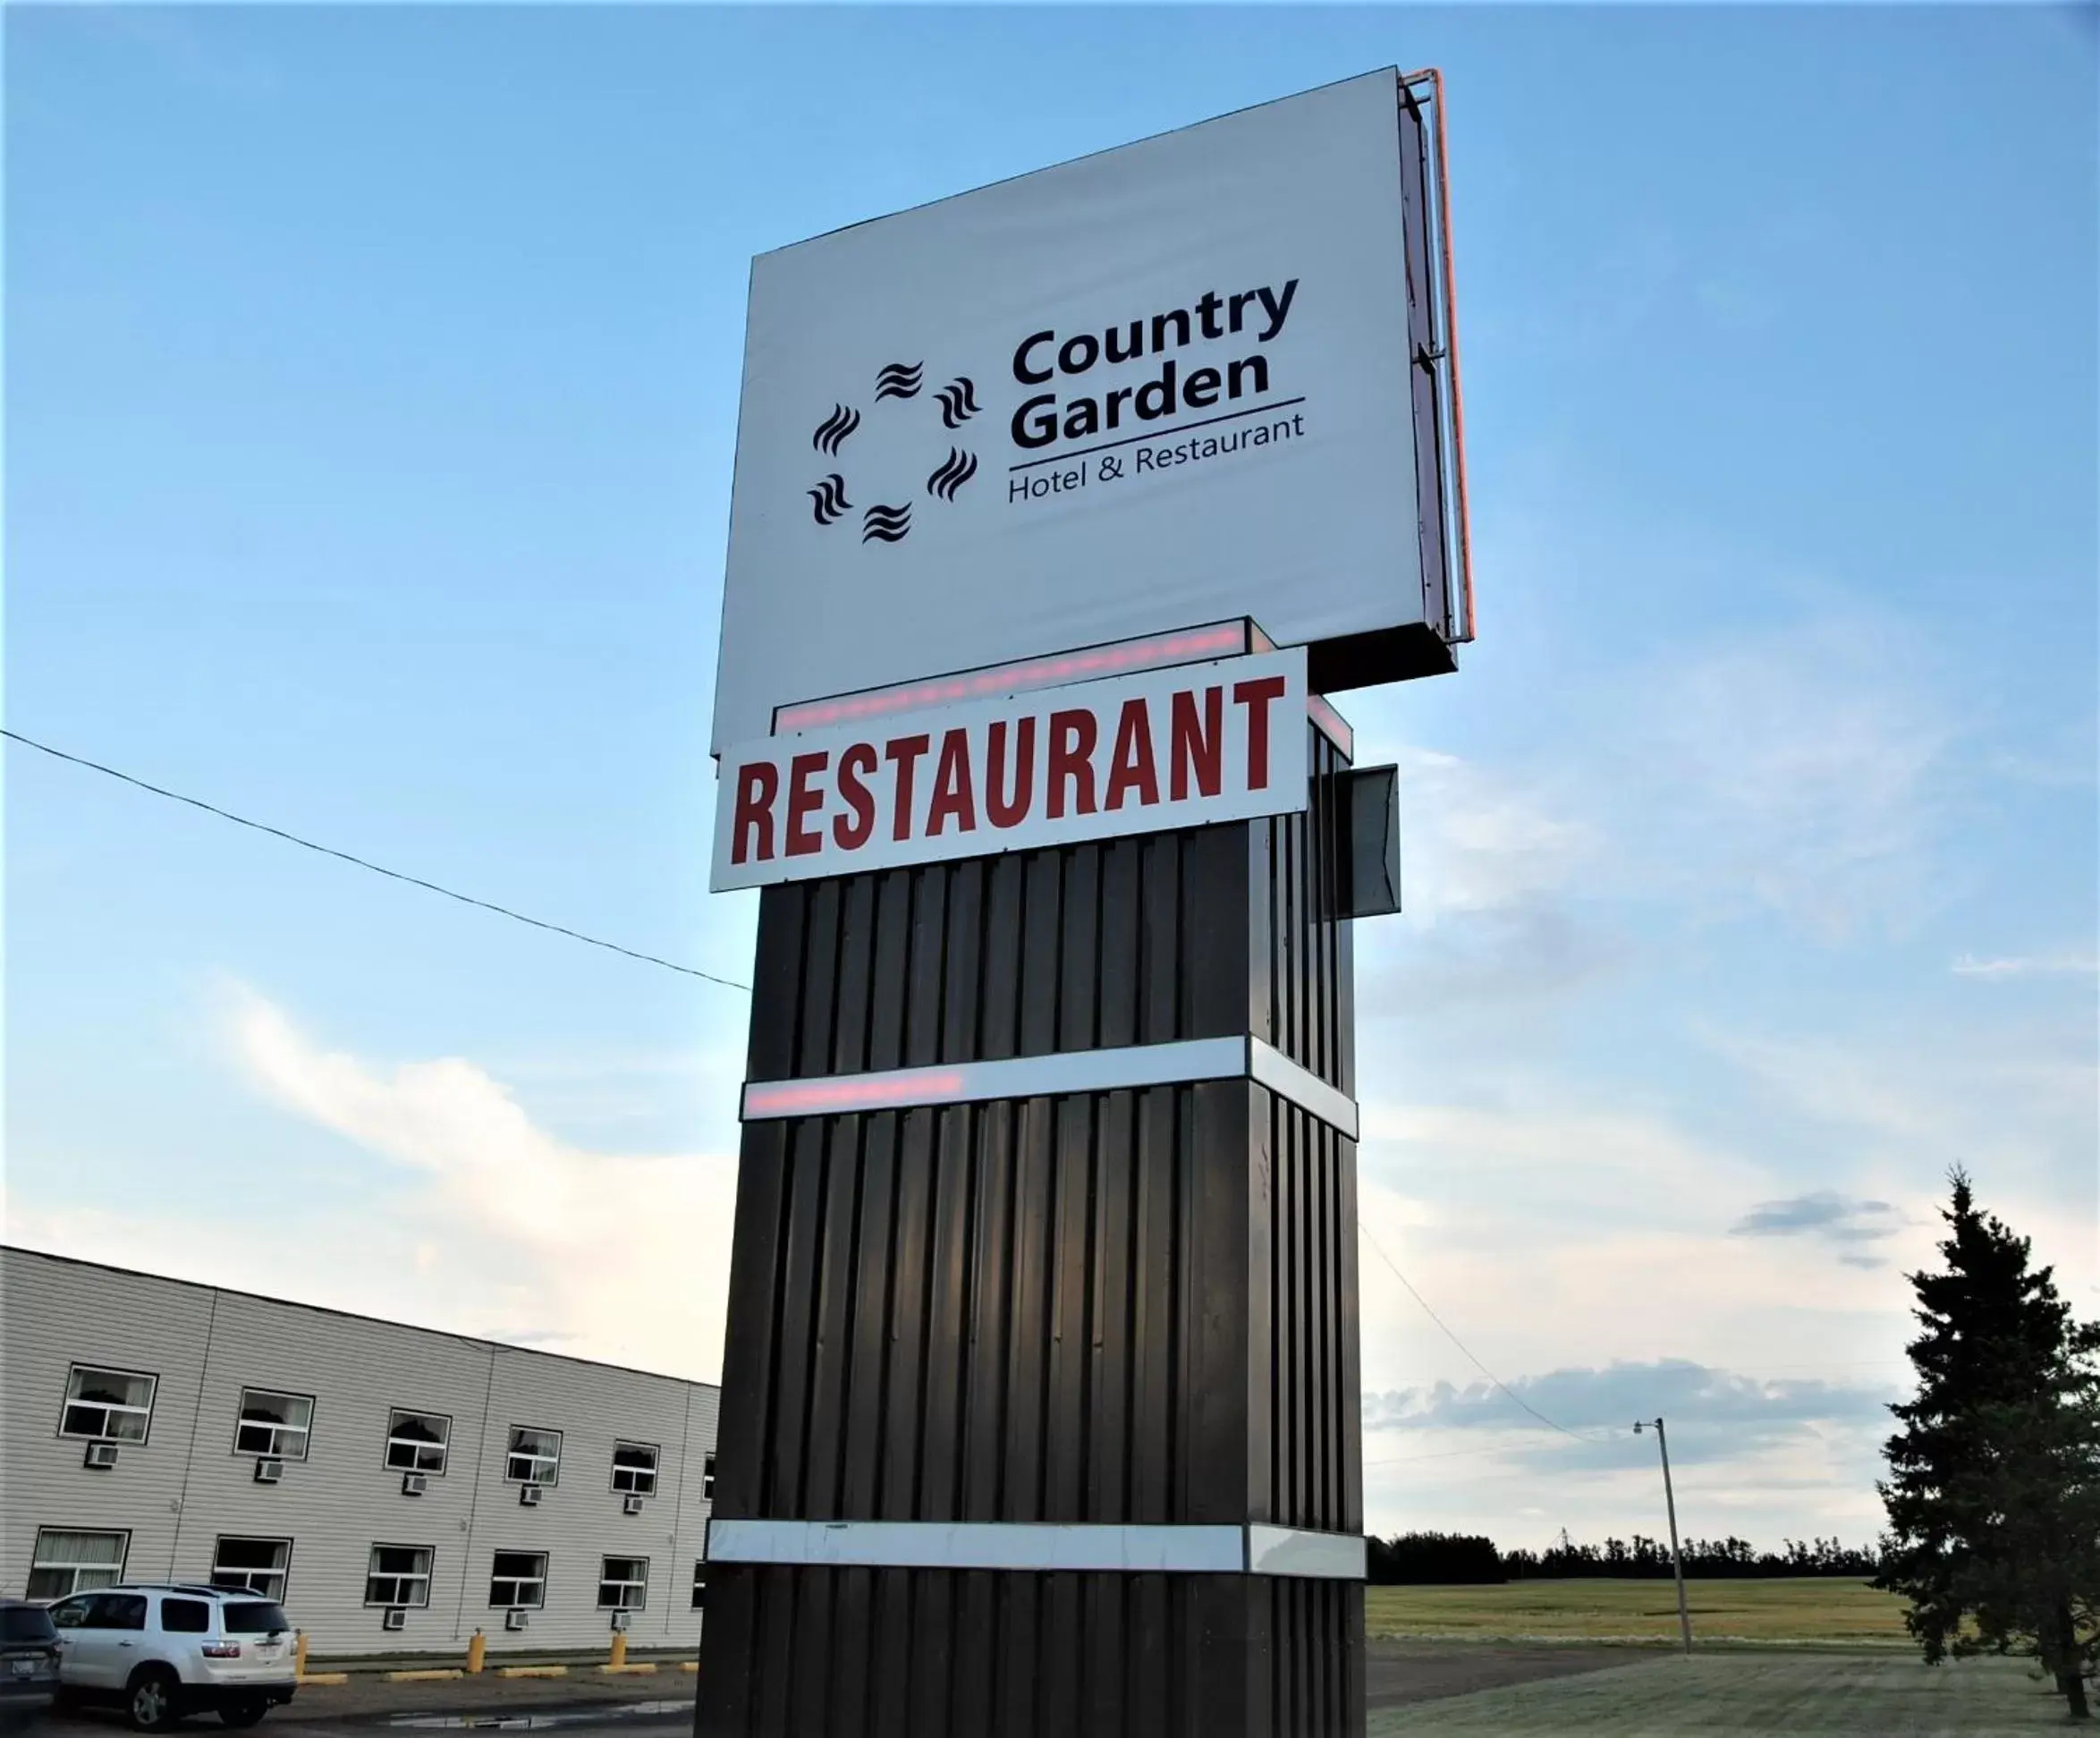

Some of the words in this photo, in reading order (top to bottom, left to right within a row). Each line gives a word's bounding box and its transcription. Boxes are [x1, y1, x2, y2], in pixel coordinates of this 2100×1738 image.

[1012, 278, 1300, 385] Country
[1011, 354, 1269, 448] Garden
[1009, 461, 1087, 503] Hotel
[1098, 456, 1124, 481] &
[1137, 413, 1306, 473] Restaurant
[731, 675, 1286, 865] RESTAURANT
